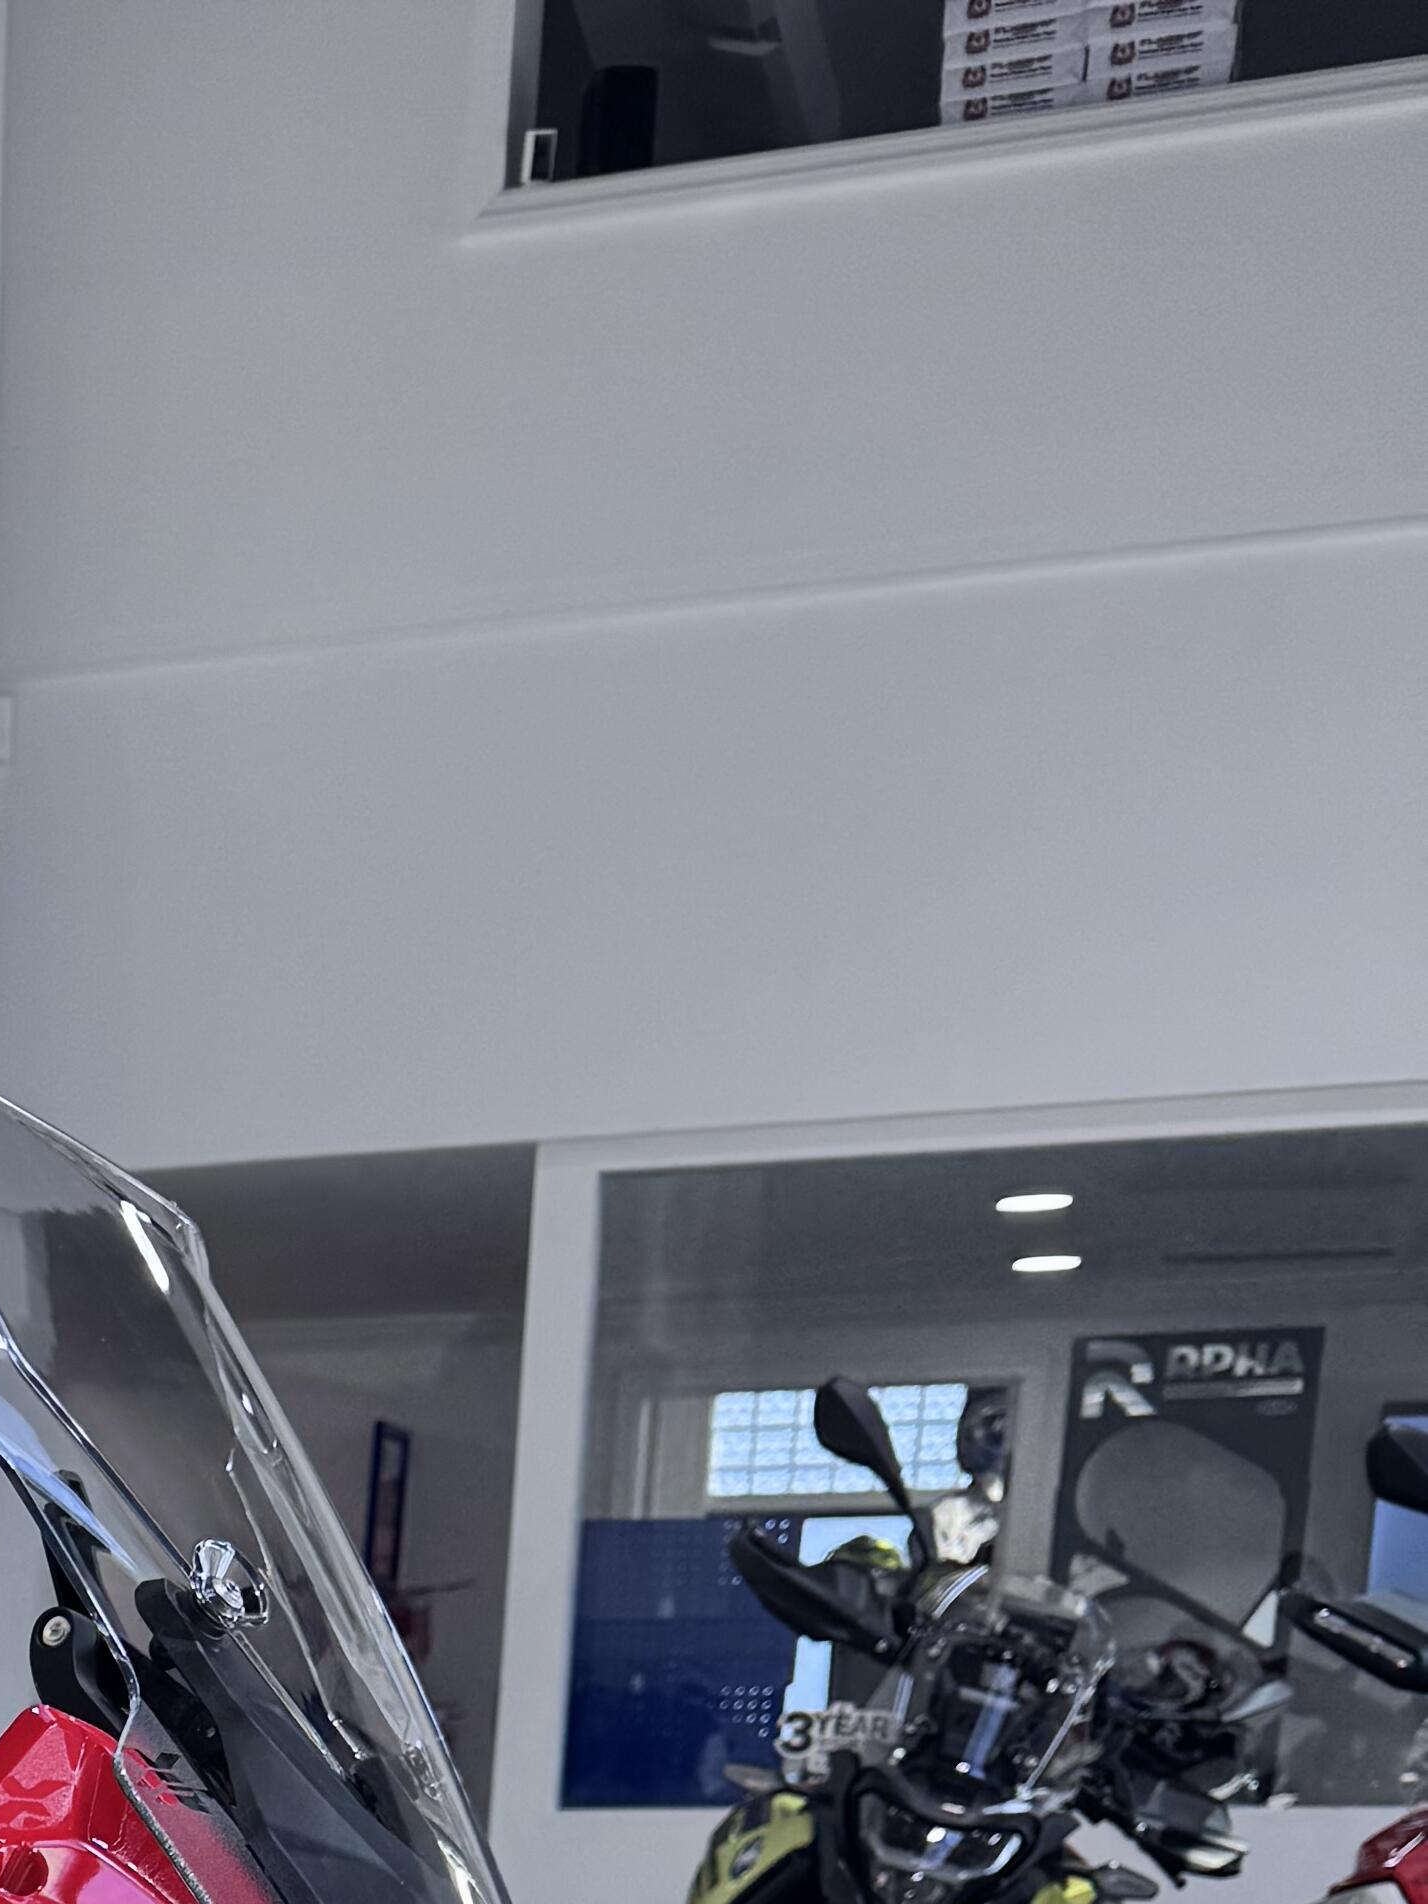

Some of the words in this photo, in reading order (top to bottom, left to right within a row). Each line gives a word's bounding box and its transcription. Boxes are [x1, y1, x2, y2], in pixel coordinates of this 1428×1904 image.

[1165, 1341, 1304, 1376] RPHA
[782, 1711, 814, 1751] 3
[816, 1714, 888, 1740] YEAR
